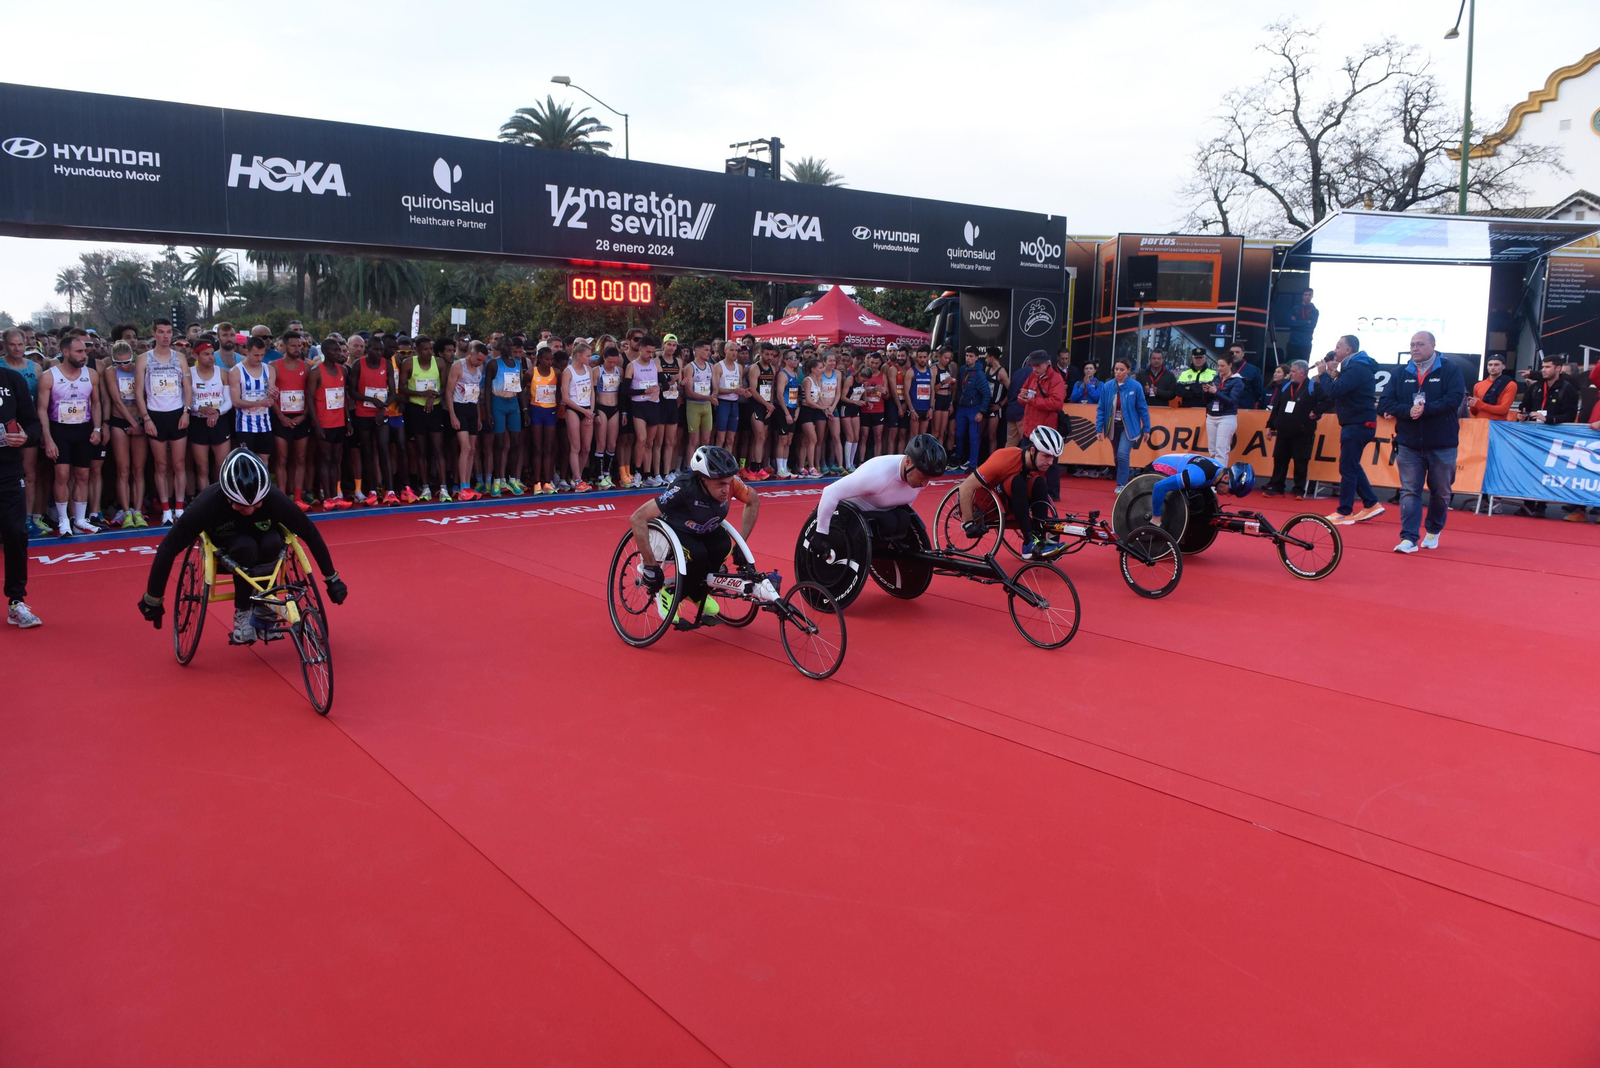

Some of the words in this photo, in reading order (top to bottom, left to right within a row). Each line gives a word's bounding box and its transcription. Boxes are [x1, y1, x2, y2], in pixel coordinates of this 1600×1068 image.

[53, 142, 161, 168] HYUNDAI
[53, 164, 123, 180] Hyundauto
[125, 168, 161, 182] Motor
[227, 153, 347, 197] HOKA
[401, 193, 494, 215] quirónsalud
[579, 187, 692, 219] maratón
[409, 215, 455, 229] Healthcare
[456, 218, 487, 231] Partner
[610, 213, 692, 240] sevilla
[752, 210, 822, 242] HOKA
[873, 229, 920, 244] HYUNDAI
[1140, 236, 1176, 247] portos
[595, 239, 611, 251] 28
[612, 242, 645, 255] enero
[647, 243, 675, 257] 2024
[873, 242, 902, 253] Hyundauto
[904, 244, 920, 253] Motor
[947, 246, 996, 262] quirónsalud
[950, 261, 974, 271] Healthcare
[975, 263, 992, 272] Partner
[573, 278, 596, 300] 00
[601, 280, 624, 302] 00
[629, 282, 651, 303] 00
[159, 379, 168, 387] 51
[67, 406, 77, 414] 66
[1541, 473, 1570, 488] FLY
[713, 576, 728, 585] TOP
[727, 578, 743, 588] END
